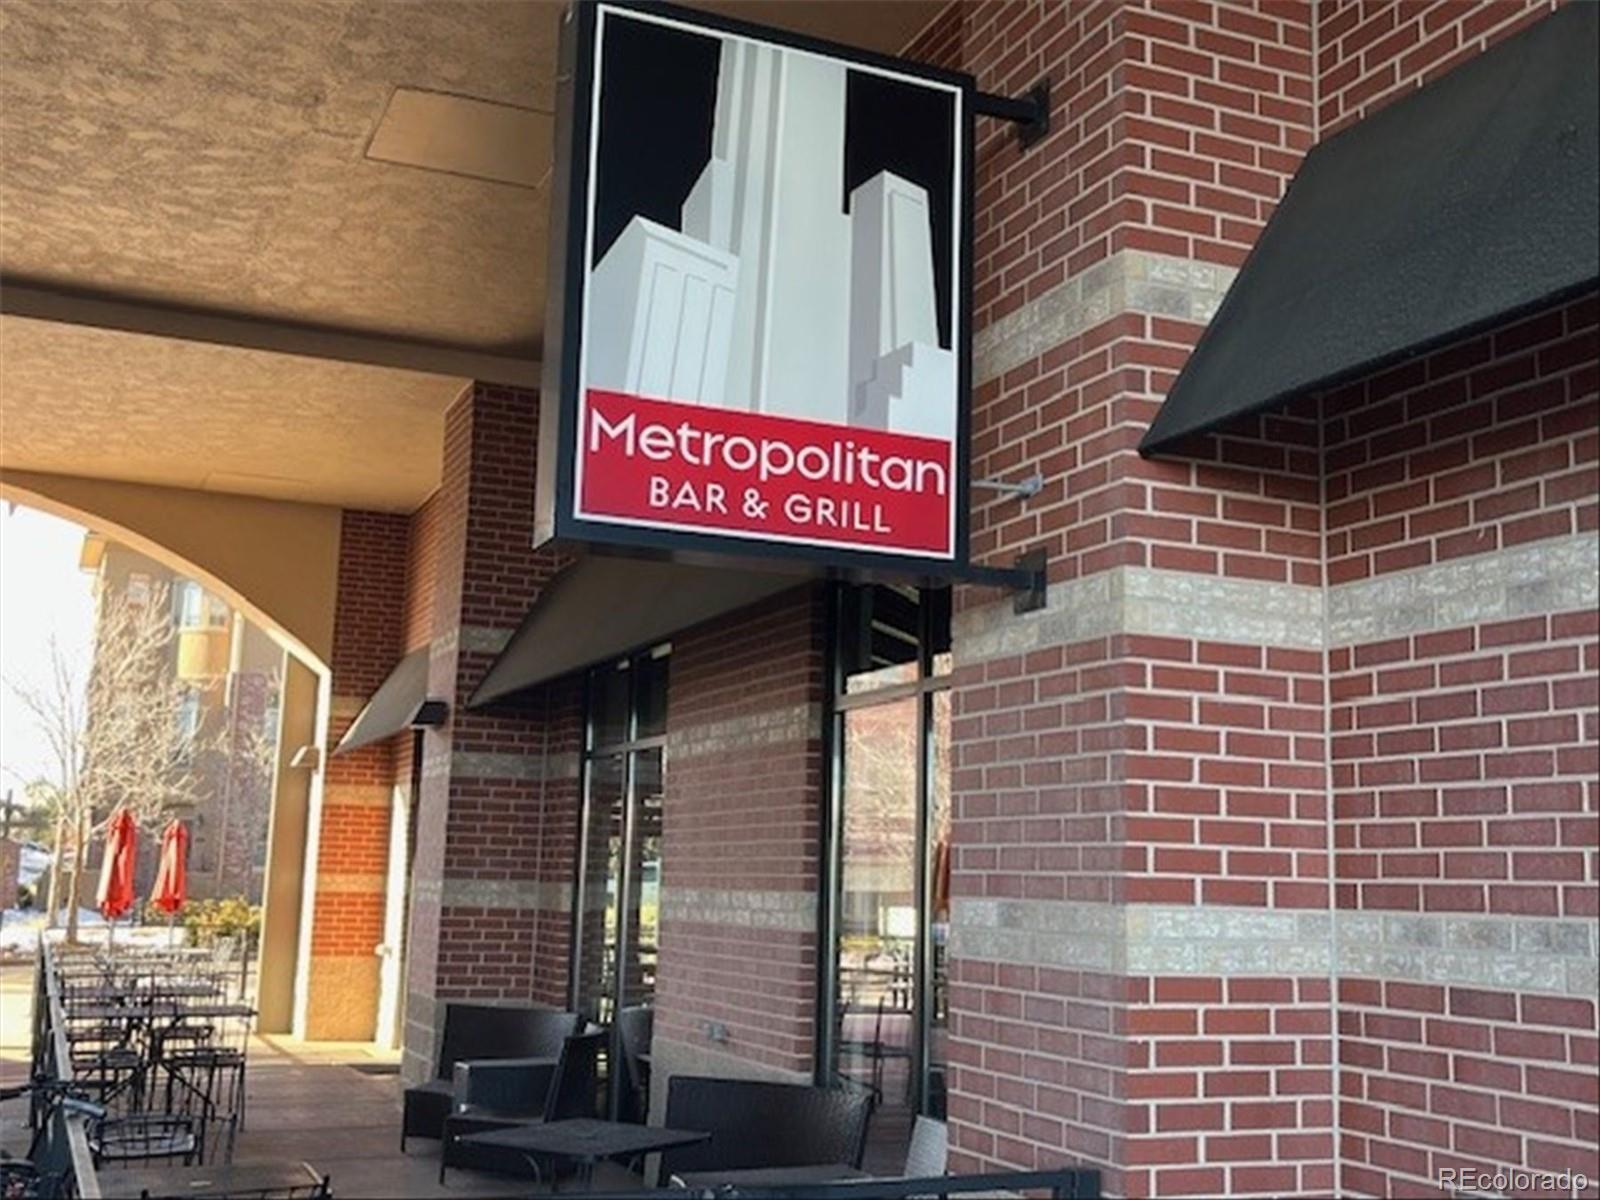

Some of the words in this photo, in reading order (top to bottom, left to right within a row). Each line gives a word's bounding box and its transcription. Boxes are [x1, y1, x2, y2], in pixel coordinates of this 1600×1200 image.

[589, 407, 946, 496] Metropolitan
[648, 476, 728, 514] BAR
[743, 488, 769, 519] &
[784, 493, 891, 533] GRILL
